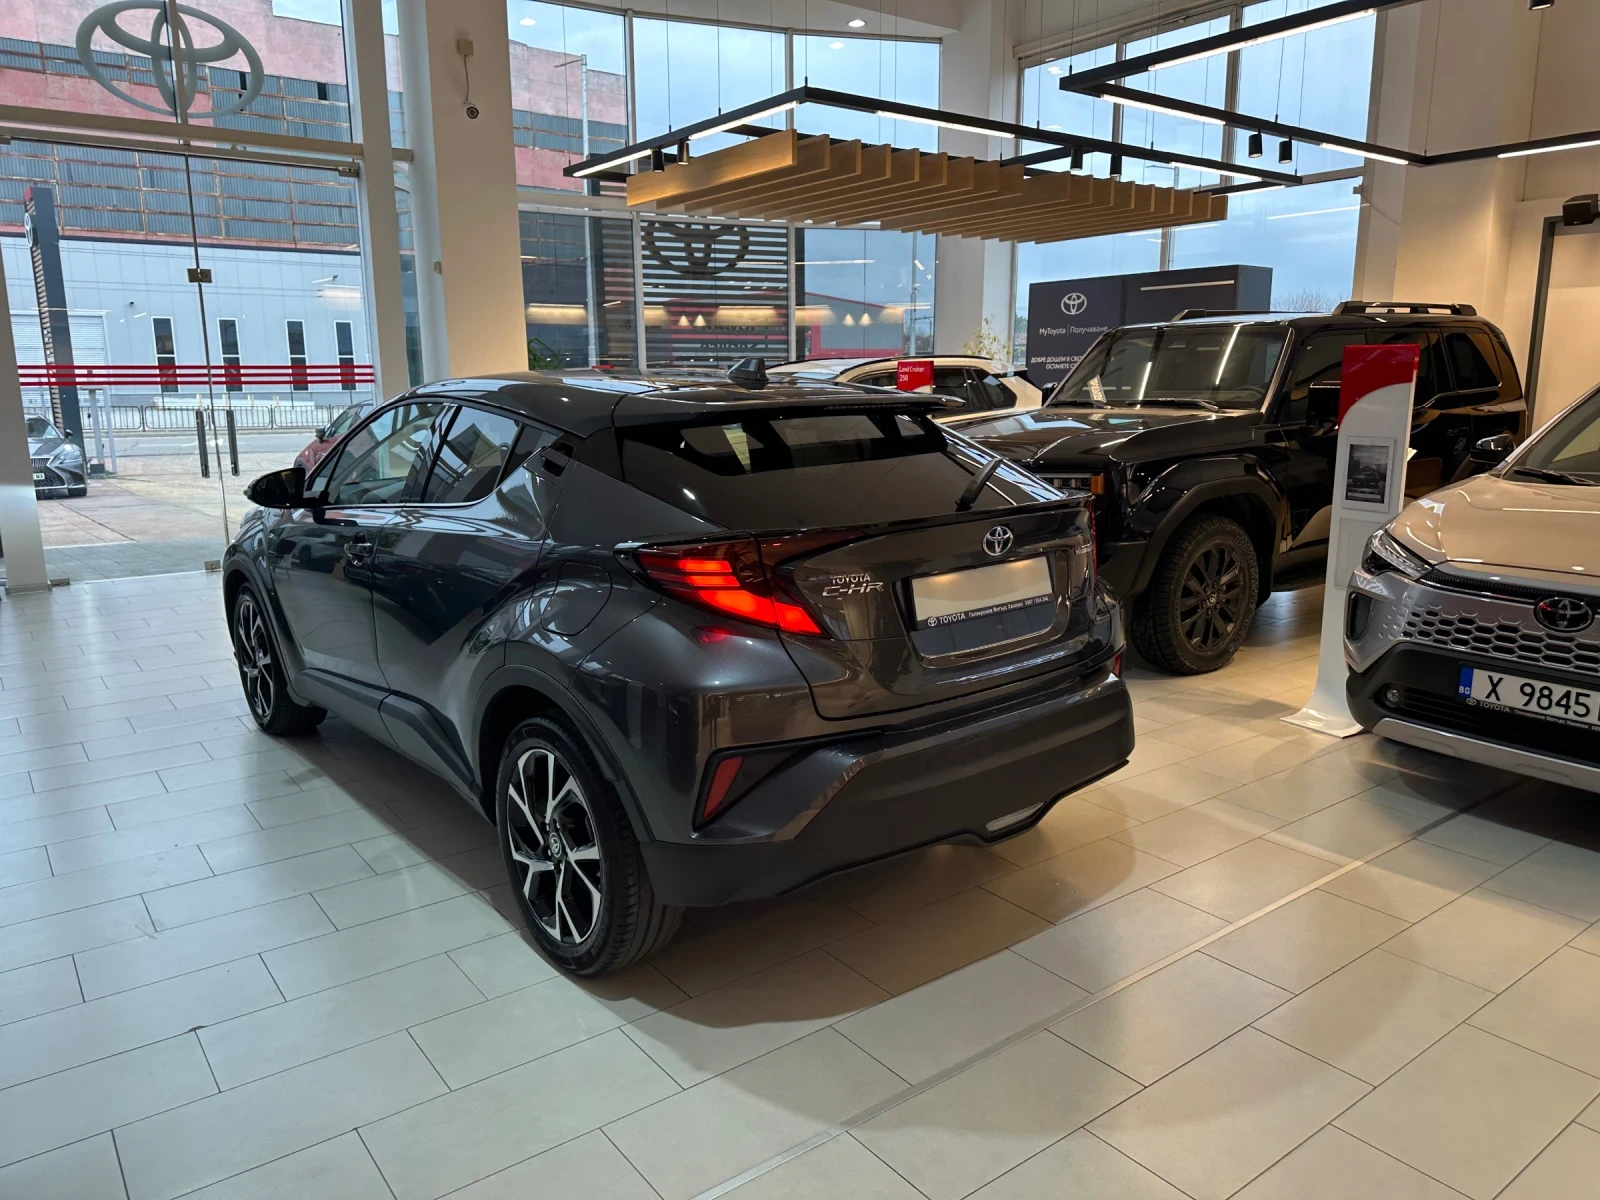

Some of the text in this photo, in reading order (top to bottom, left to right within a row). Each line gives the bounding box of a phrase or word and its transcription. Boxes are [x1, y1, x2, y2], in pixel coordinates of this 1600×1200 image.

[1039, 327, 1066, 336] MyToyota
[830, 573, 871, 584] TOYOTA
[822, 582, 884, 597] C-HR
[939, 613, 966, 624] TOYOTA
[1458, 685, 1470, 695] BG
[1519, 682, 1591, 718] 9845
[1479, 700, 1511, 713] TOYOTA
